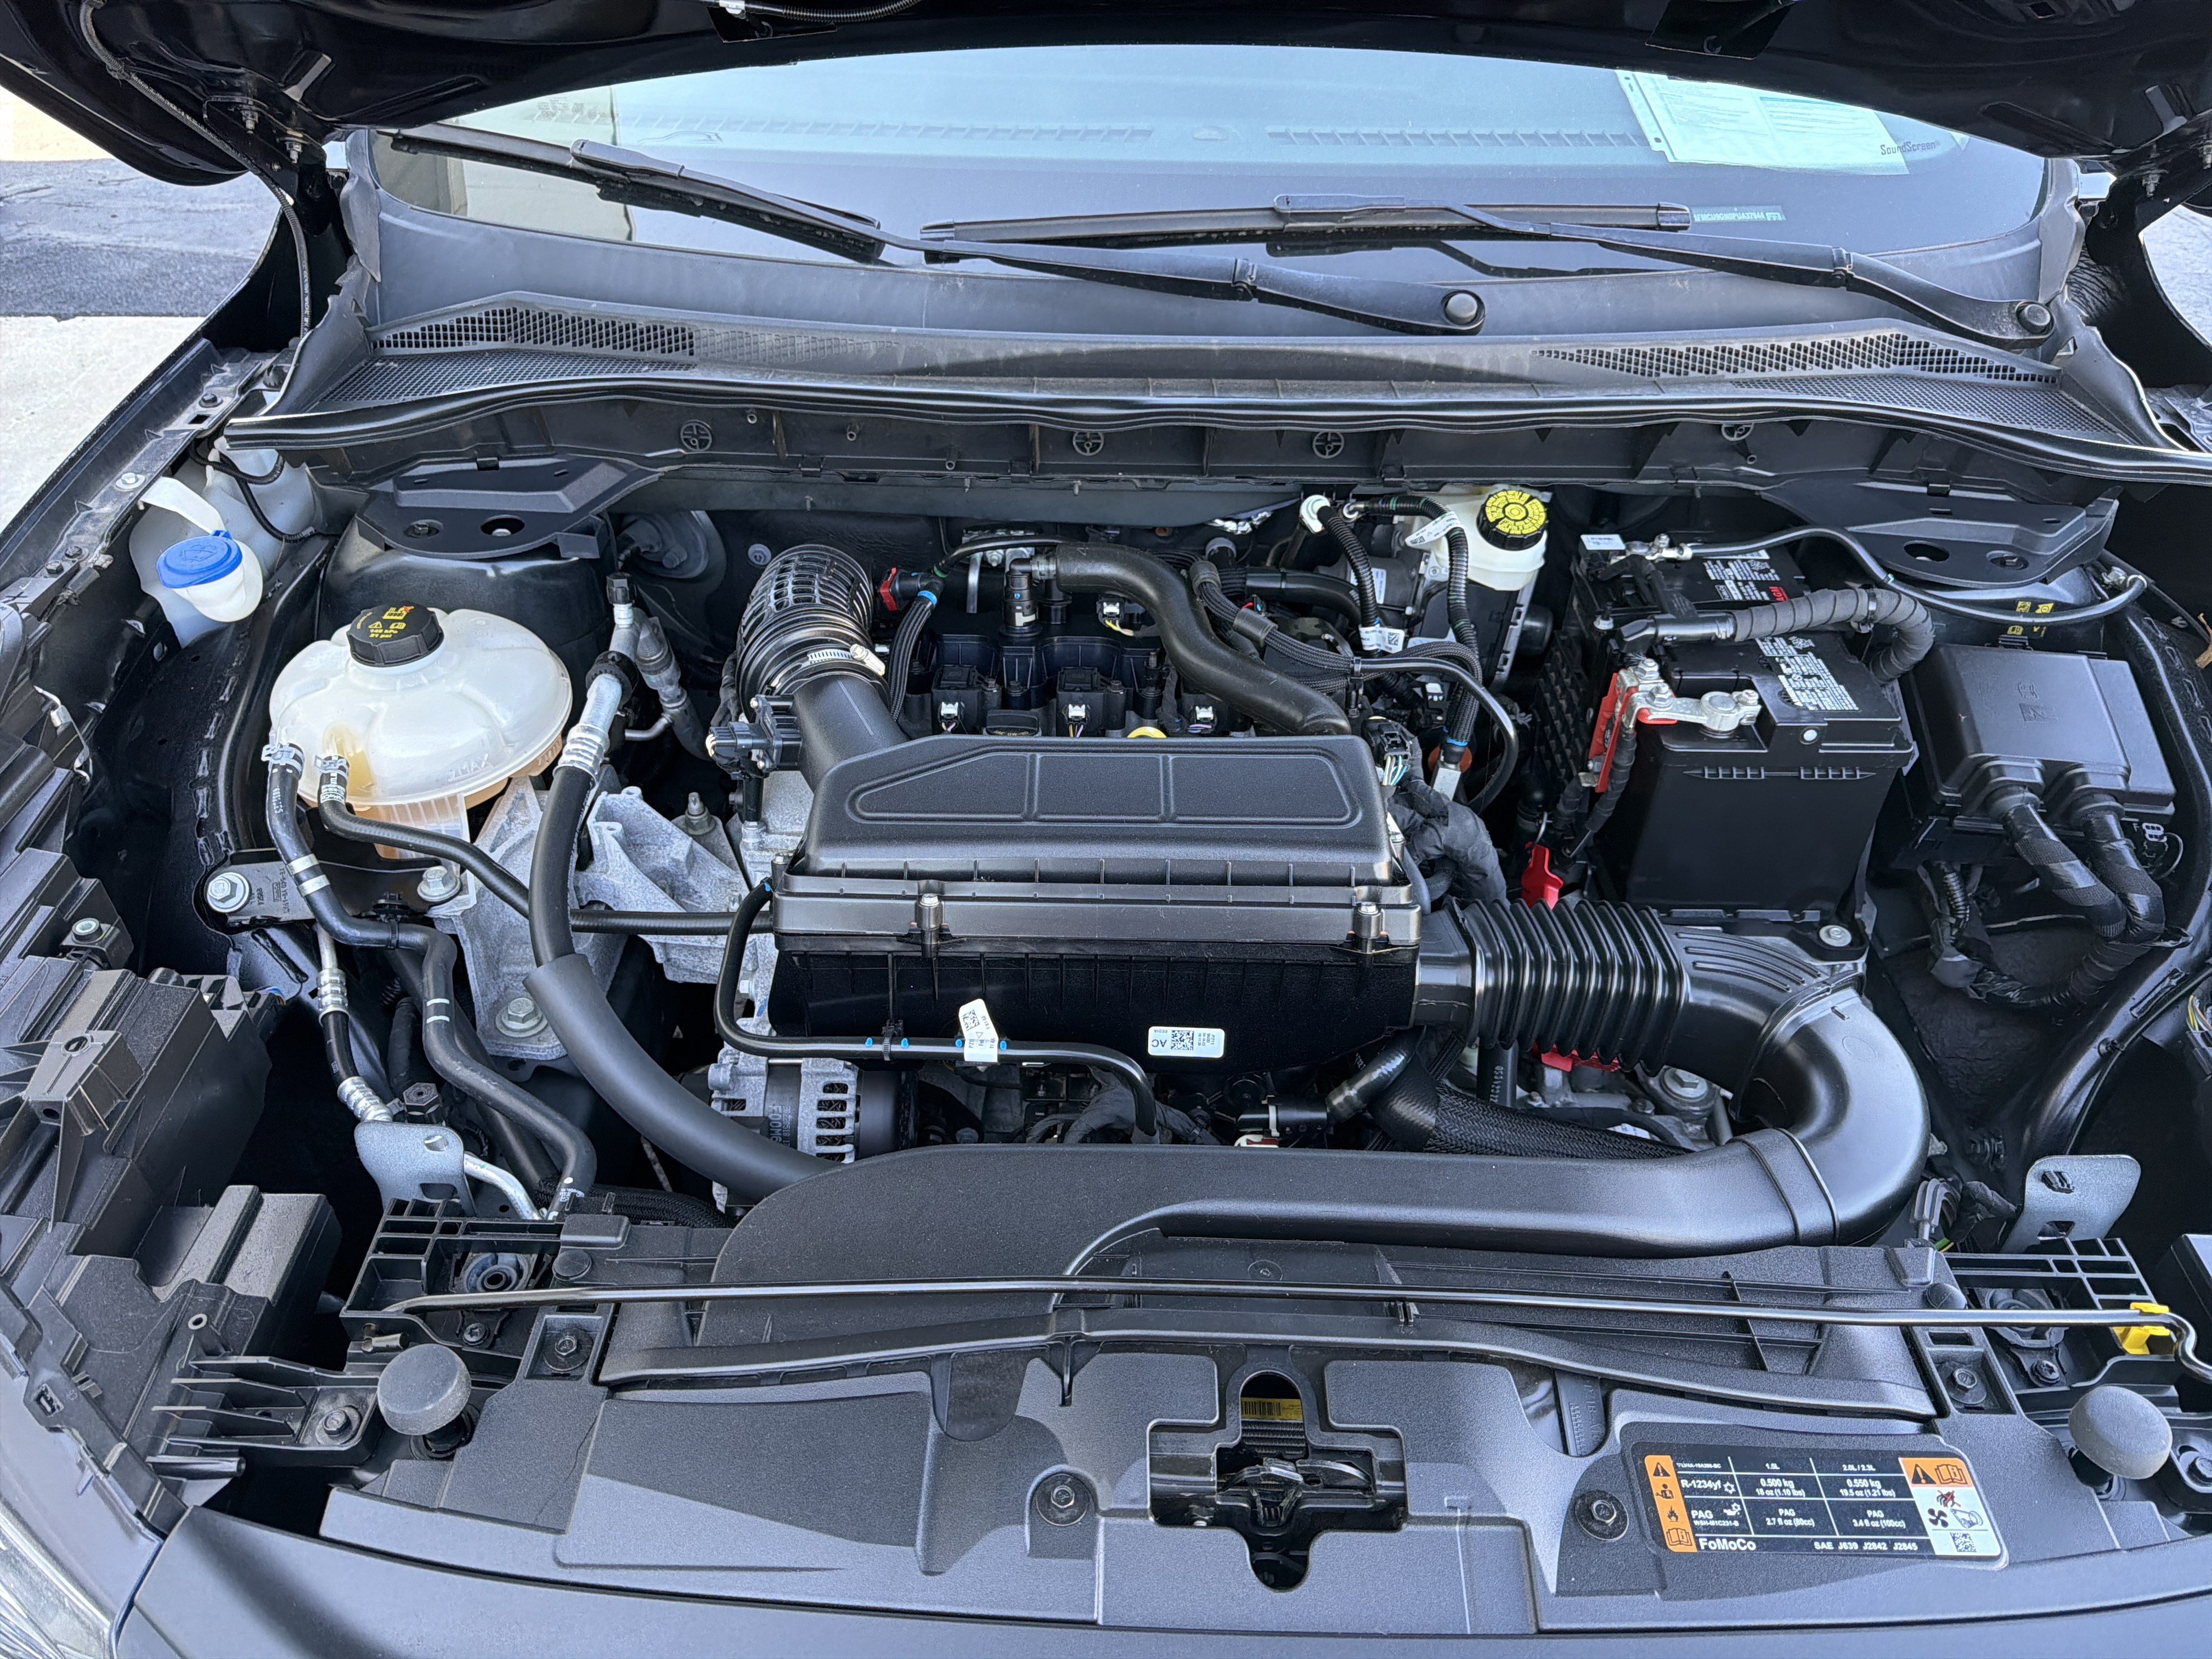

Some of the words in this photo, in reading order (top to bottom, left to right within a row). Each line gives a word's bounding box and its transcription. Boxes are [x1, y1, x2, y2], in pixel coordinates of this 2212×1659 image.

[1151, 1039, 1167, 1048] AC
[1680, 1479, 1722, 1491] R-1234yf
[1760, 1479, 1782, 1487] 0.500
[1782, 1479, 1795, 1489] kg
[1846, 1479, 1869, 1487] 0.550
[1869, 1479, 1882, 1489] kg
[1775, 1489, 1791, 1497] (1.10
[1791, 1489, 1805, 1498] lbs)
[1864, 1489, 1881, 1498] (1.21
[1882, 1489, 1896, 1498] lbs)
[1691, 1510, 1714, 1520] PAG
[1866, 1510, 1884, 1518] PAG
[1765, 1517, 1777, 1526] 2.7
[1793, 1518, 1815, 1527] (80cc)
[1880, 1520, 1906, 1528] (100cc)
[1699, 1538, 1757, 1551] FoMoCo
[1814, 1542, 1835, 1550] SAE
[1838, 1542, 1859, 1550] J639
[1863, 1542, 1888, 1550] J2842
[1893, 1542, 1918, 1551] J2845
